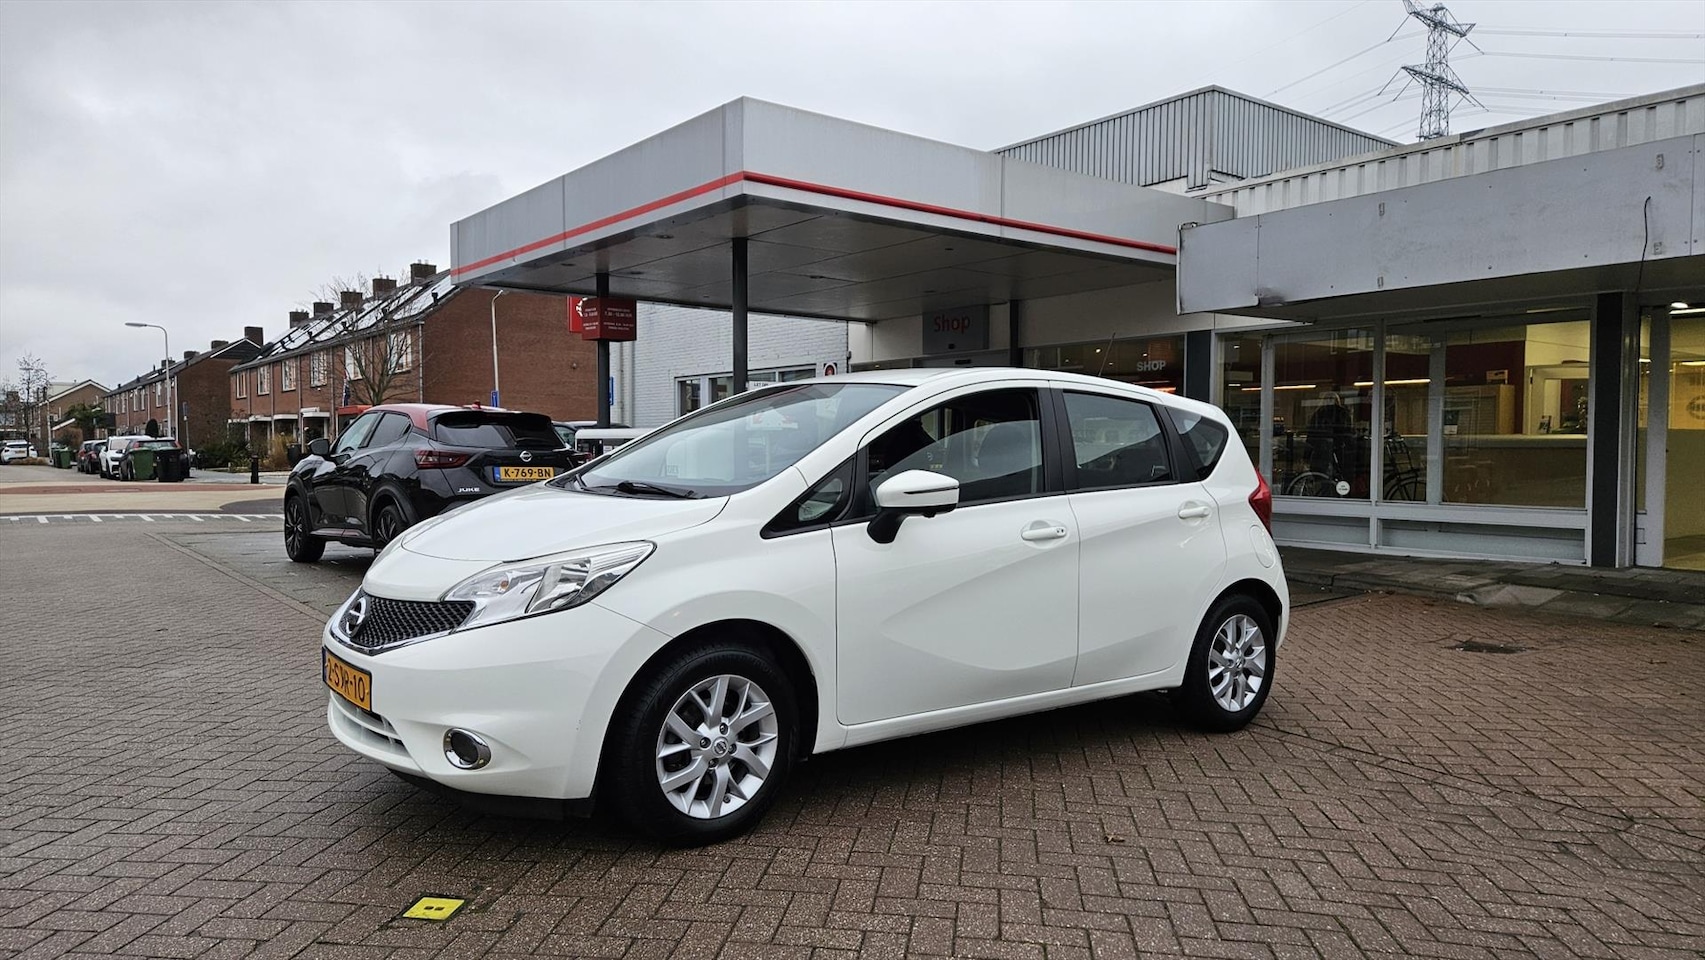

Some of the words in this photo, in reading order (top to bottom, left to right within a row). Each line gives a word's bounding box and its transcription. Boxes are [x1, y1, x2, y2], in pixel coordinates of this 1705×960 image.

[934, 314, 971, 335] Shop
[1137, 360, 1167, 372] SHOP
[504, 468, 551, 478] K-769-BN
